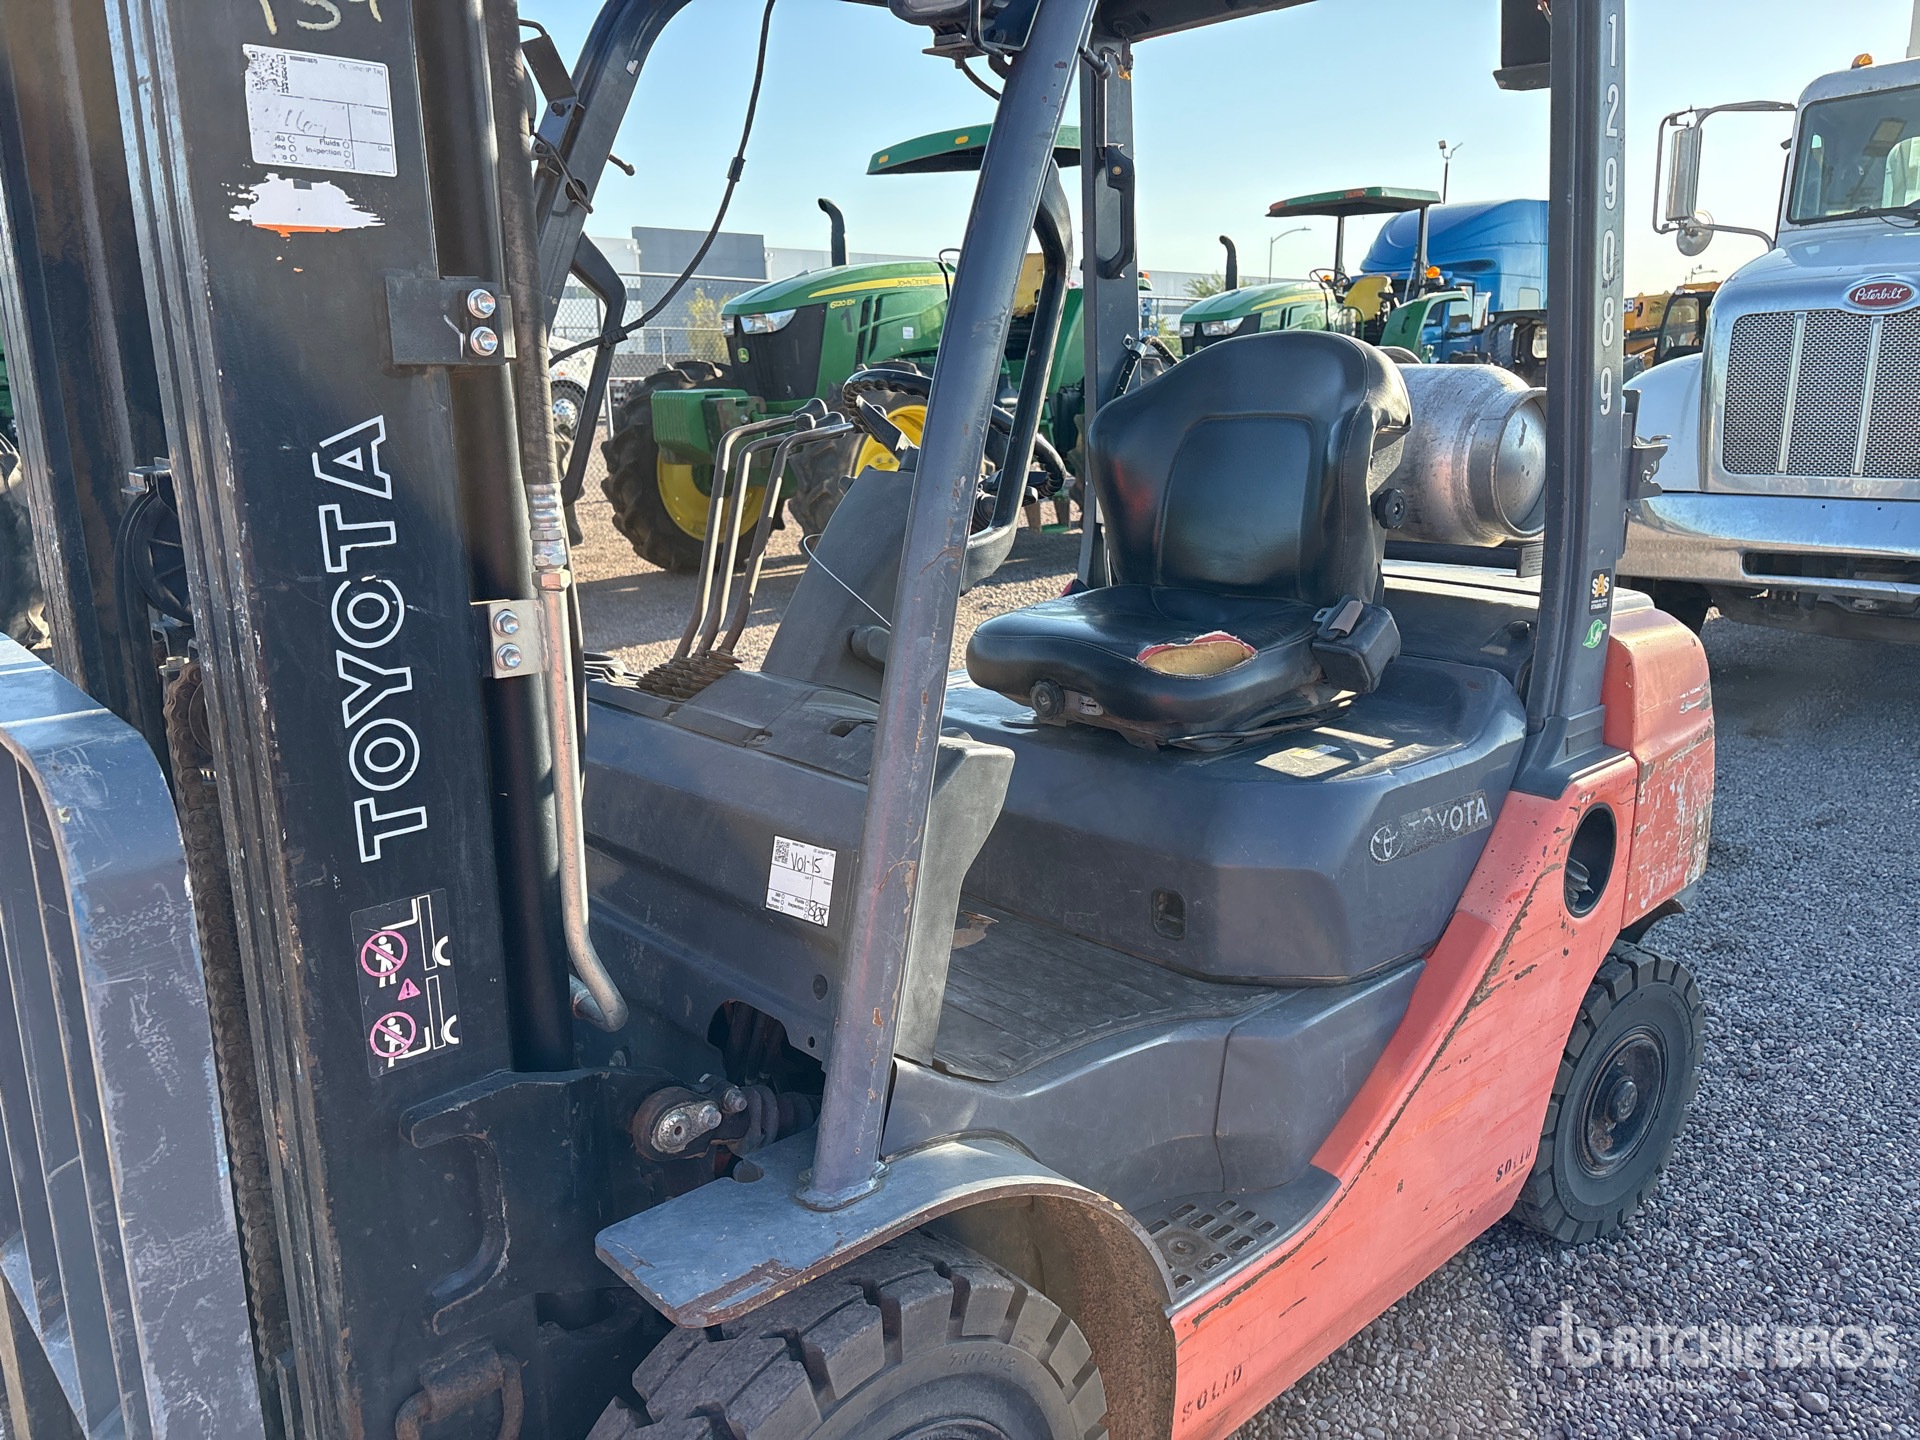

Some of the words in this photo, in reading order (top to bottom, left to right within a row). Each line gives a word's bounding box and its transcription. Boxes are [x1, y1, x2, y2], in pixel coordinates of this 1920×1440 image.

[319, 139, 340, 147] Fluids
[1855, 287, 1908, 302] Peterbilt
[1591, 573, 1610, 598] SAS
[312, 414, 428, 863] TOYOTA
[1182, 1364, 1243, 1423] SOLID
